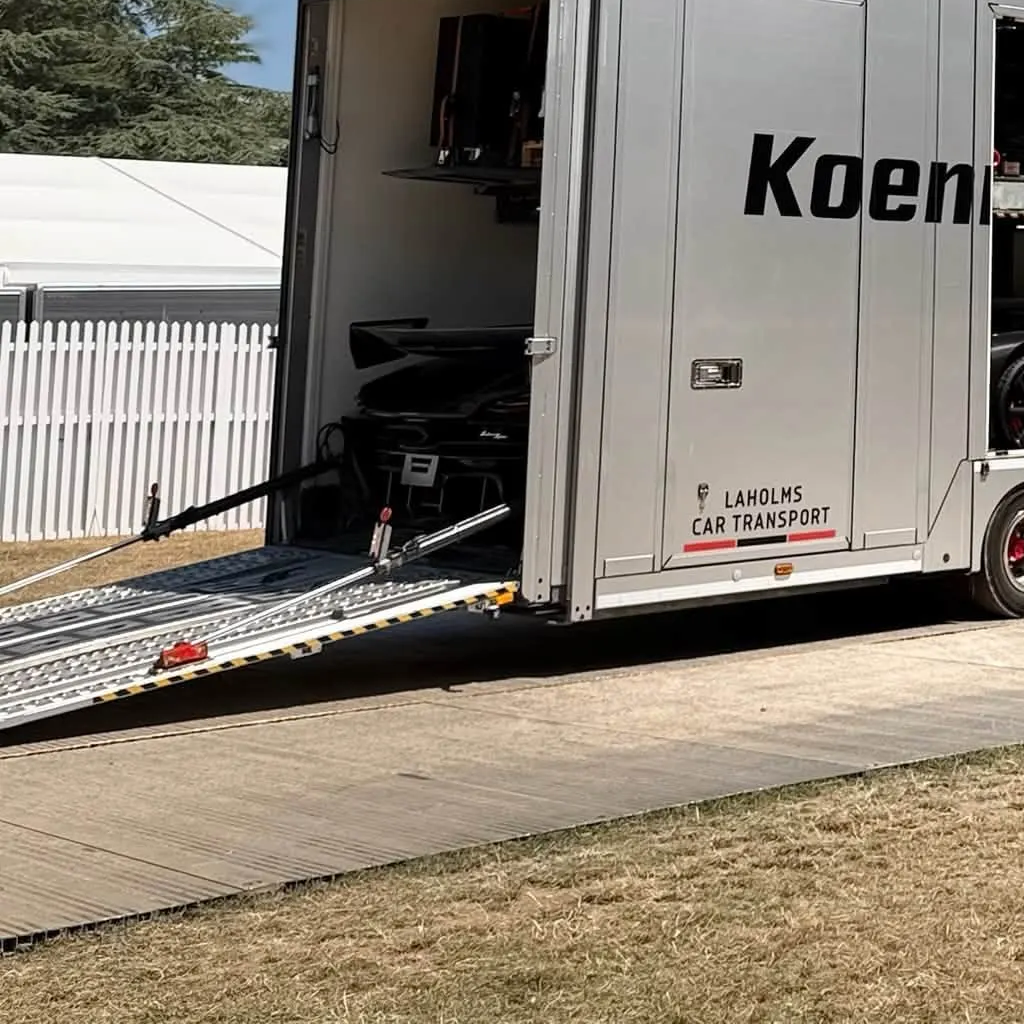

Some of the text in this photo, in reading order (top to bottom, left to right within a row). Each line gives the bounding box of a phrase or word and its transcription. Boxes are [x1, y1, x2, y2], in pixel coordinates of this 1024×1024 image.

[725, 485, 803, 508] LAHOLMS
[692, 506, 830, 536] CAR TRANSPORT
